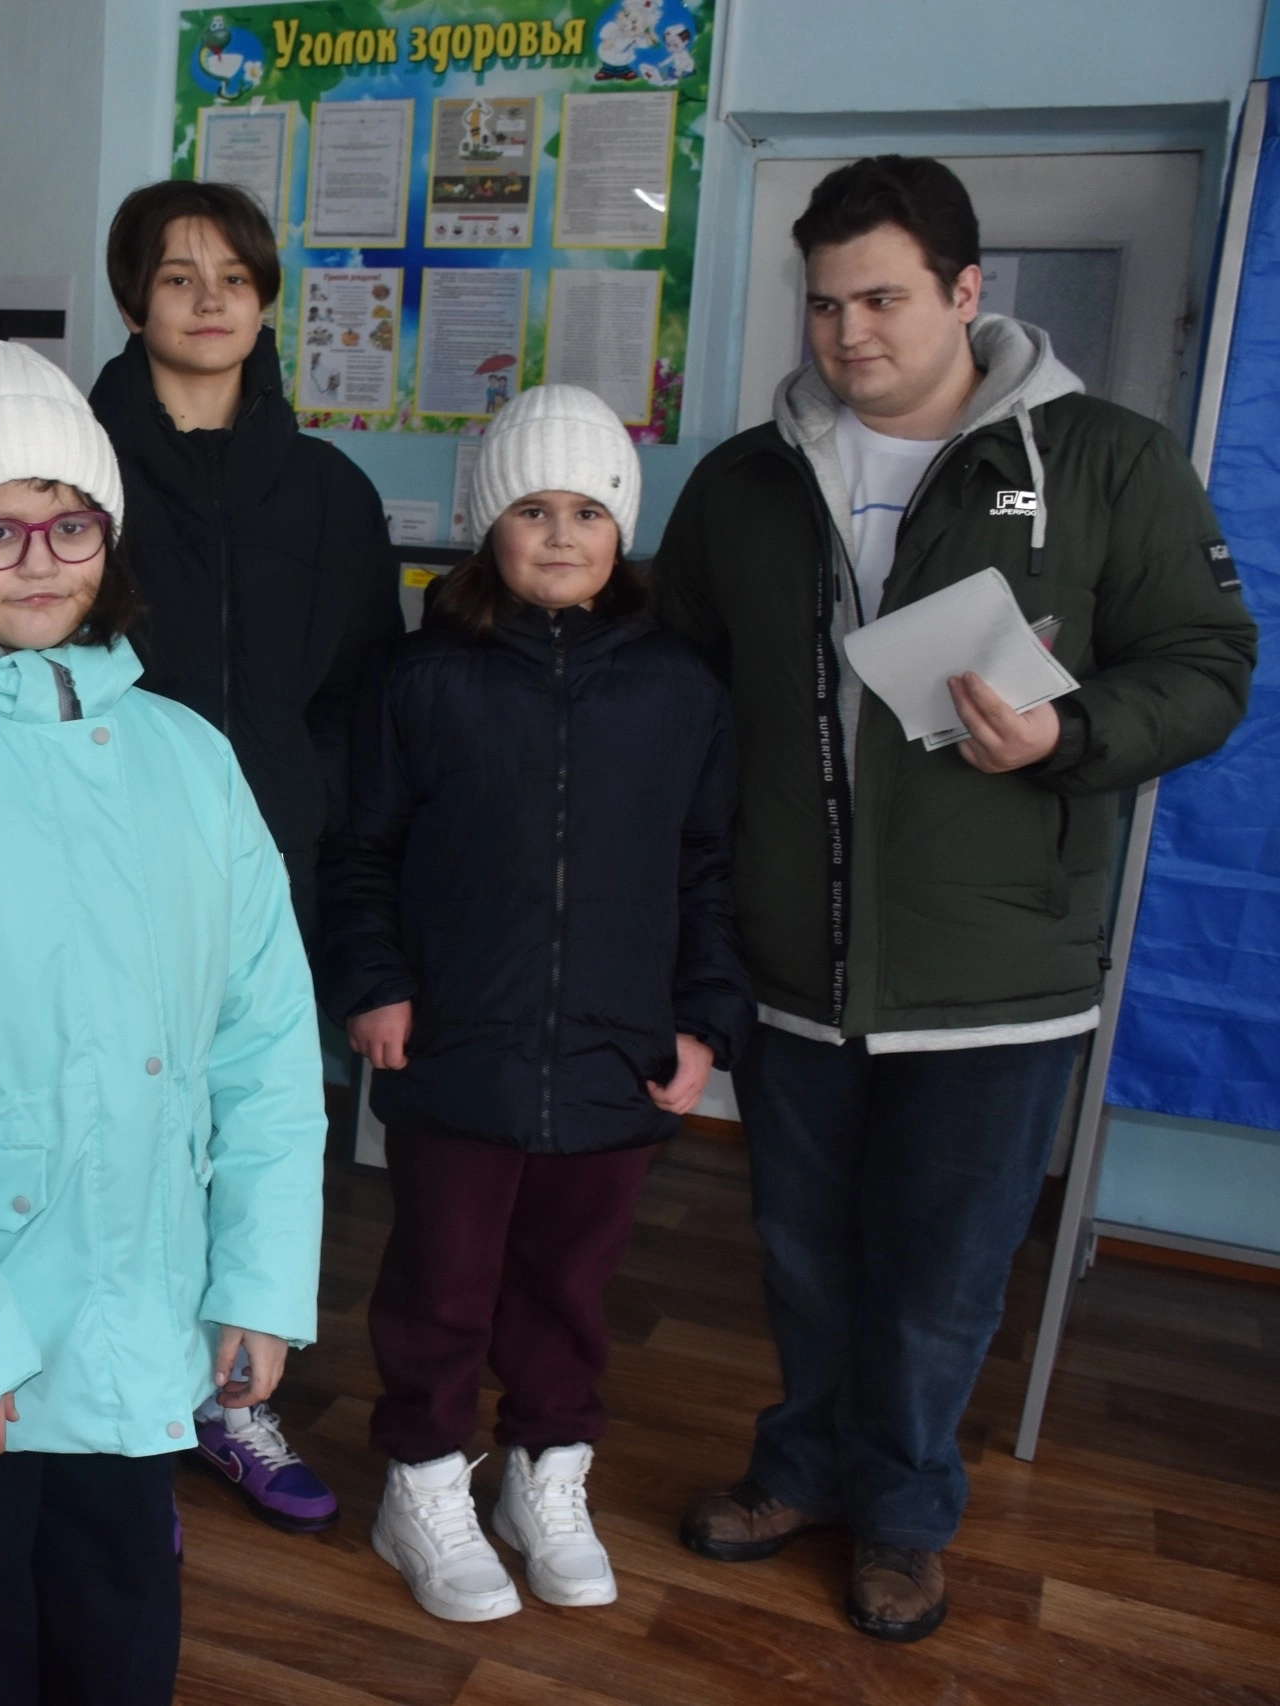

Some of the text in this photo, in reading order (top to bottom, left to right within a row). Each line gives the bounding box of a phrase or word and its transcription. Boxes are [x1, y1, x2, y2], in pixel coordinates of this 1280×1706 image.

[273, 19, 586, 73] Уголок здоровья
[818, 715, 834, 782] SUPERPOGO
